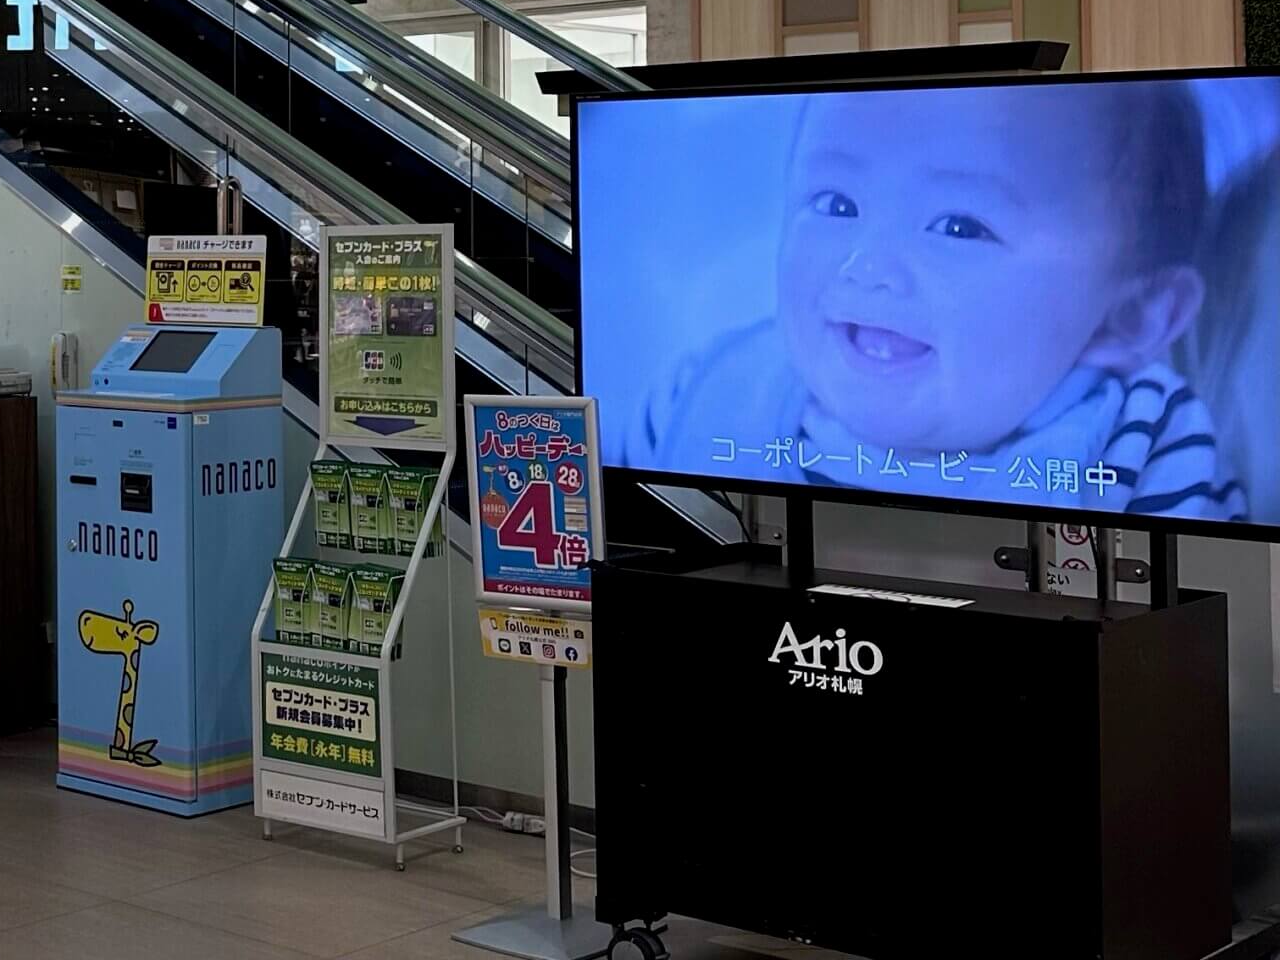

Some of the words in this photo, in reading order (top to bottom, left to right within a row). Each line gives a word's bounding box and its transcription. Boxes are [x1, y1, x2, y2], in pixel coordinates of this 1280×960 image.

[201, 458, 277, 497] nanaco
[711, 437, 997, 482] コーポレートムービー
[1007, 456, 1118, 497] 公開中
[78, 521, 158, 562] nanaco
[504, 620, 540, 634] follow
[543, 626, 569, 638] me!!
[768, 621, 884, 676] Ario
[266, 664, 376, 690] おトクにたまるクレジットカード
[788, 669, 863, 696] アリオ札幌
[271, 687, 371, 717] セブンカード・プラス
[276, 705, 363, 734] 新規会員募集中!
